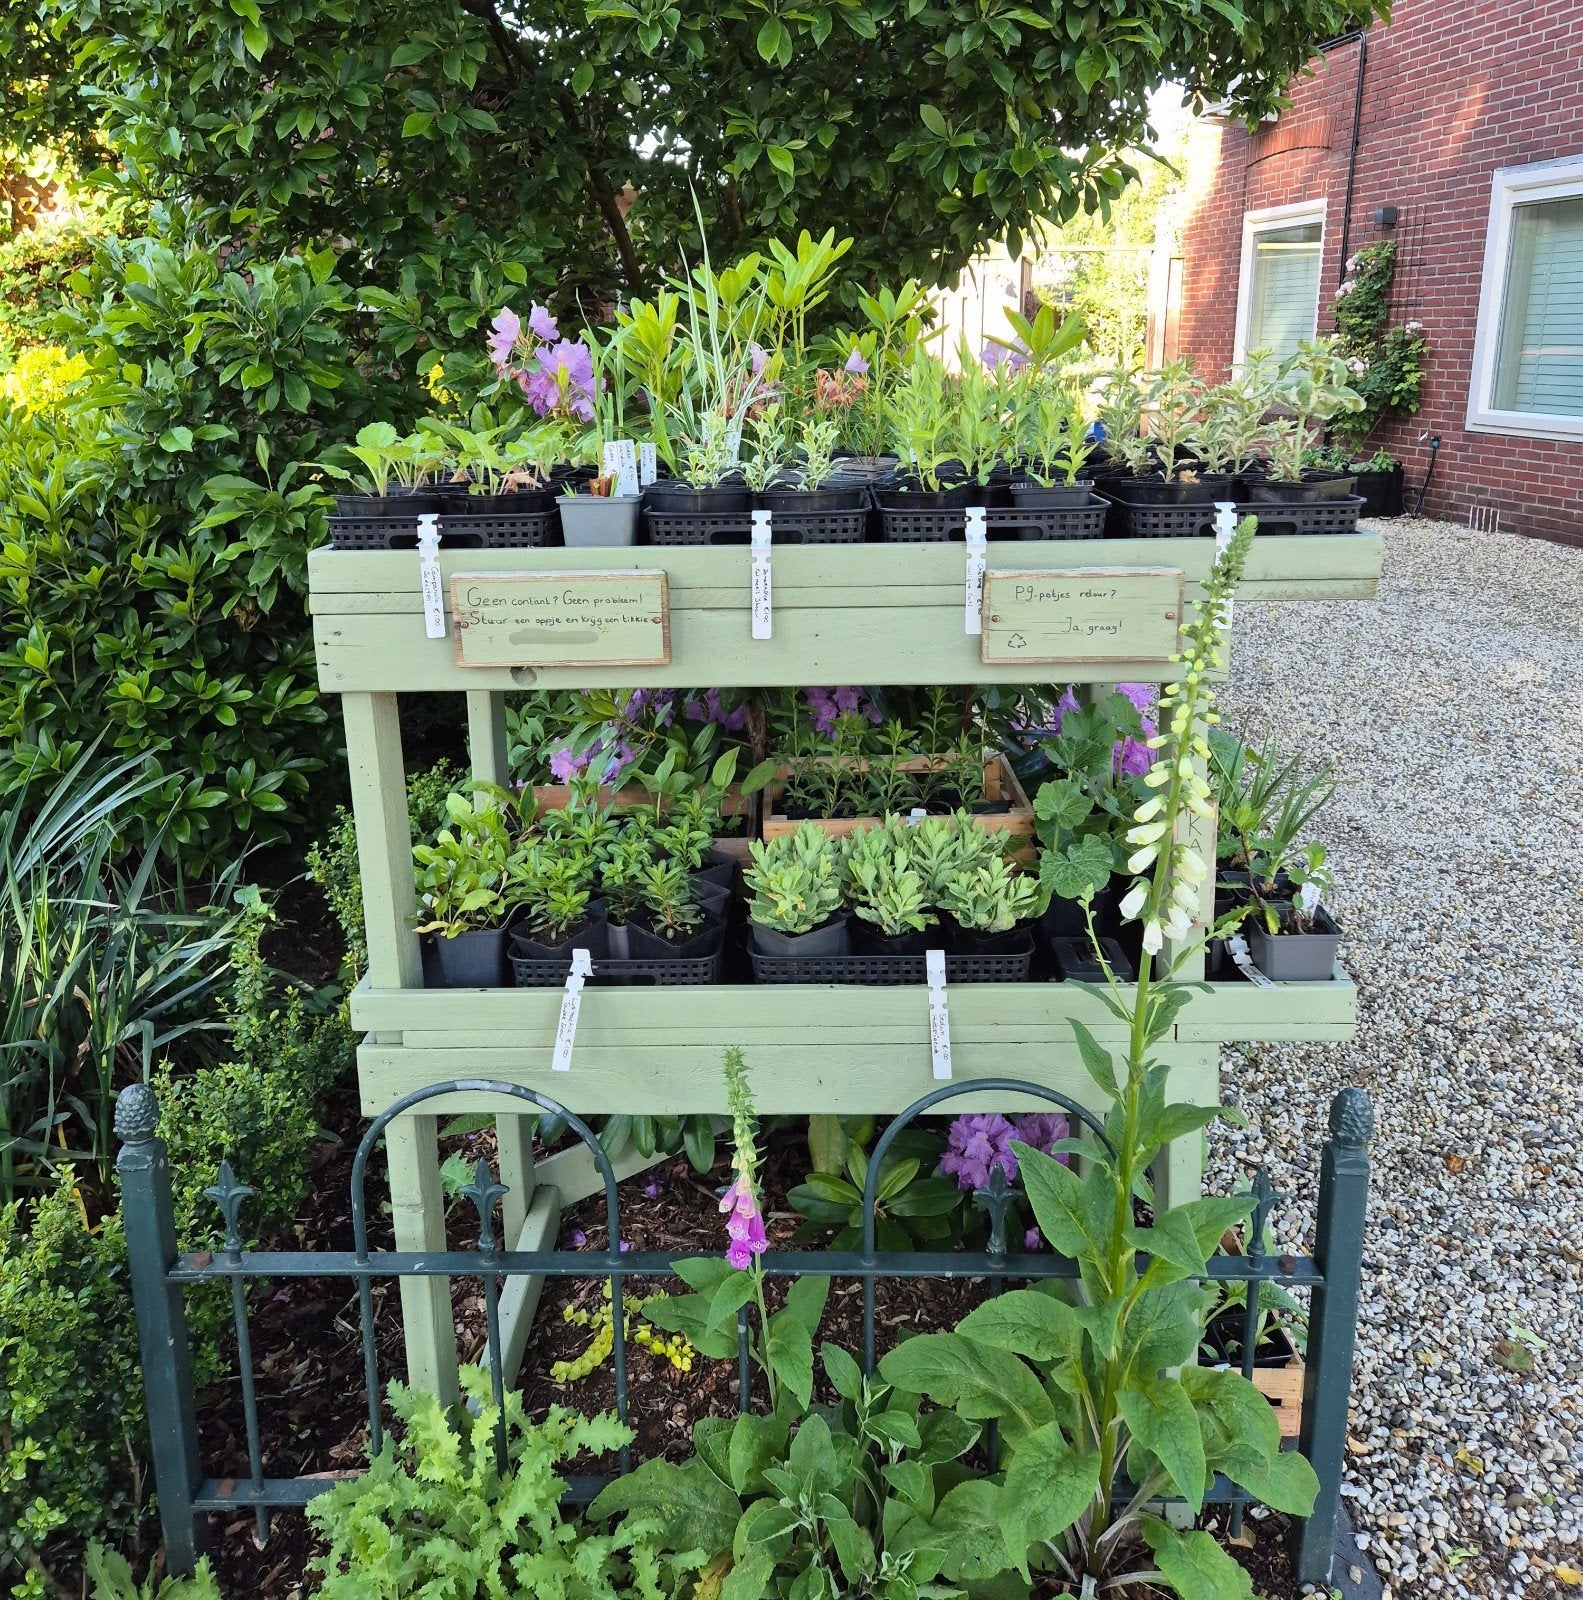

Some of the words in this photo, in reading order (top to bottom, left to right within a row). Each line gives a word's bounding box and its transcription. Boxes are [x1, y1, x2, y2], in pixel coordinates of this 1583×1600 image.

[467, 586, 507, 607] Geen
[563, 589, 590, 606] Geen
[594, 593, 643, 608] probleem!
[469, 610, 508, 626] Stuur
[514, 617, 531, 625] een
[535, 617, 562, 627] appje
[565, 616, 579, 624] en
[605, 616, 619, 624] een
[1086, 619, 1122, 636] graag!
